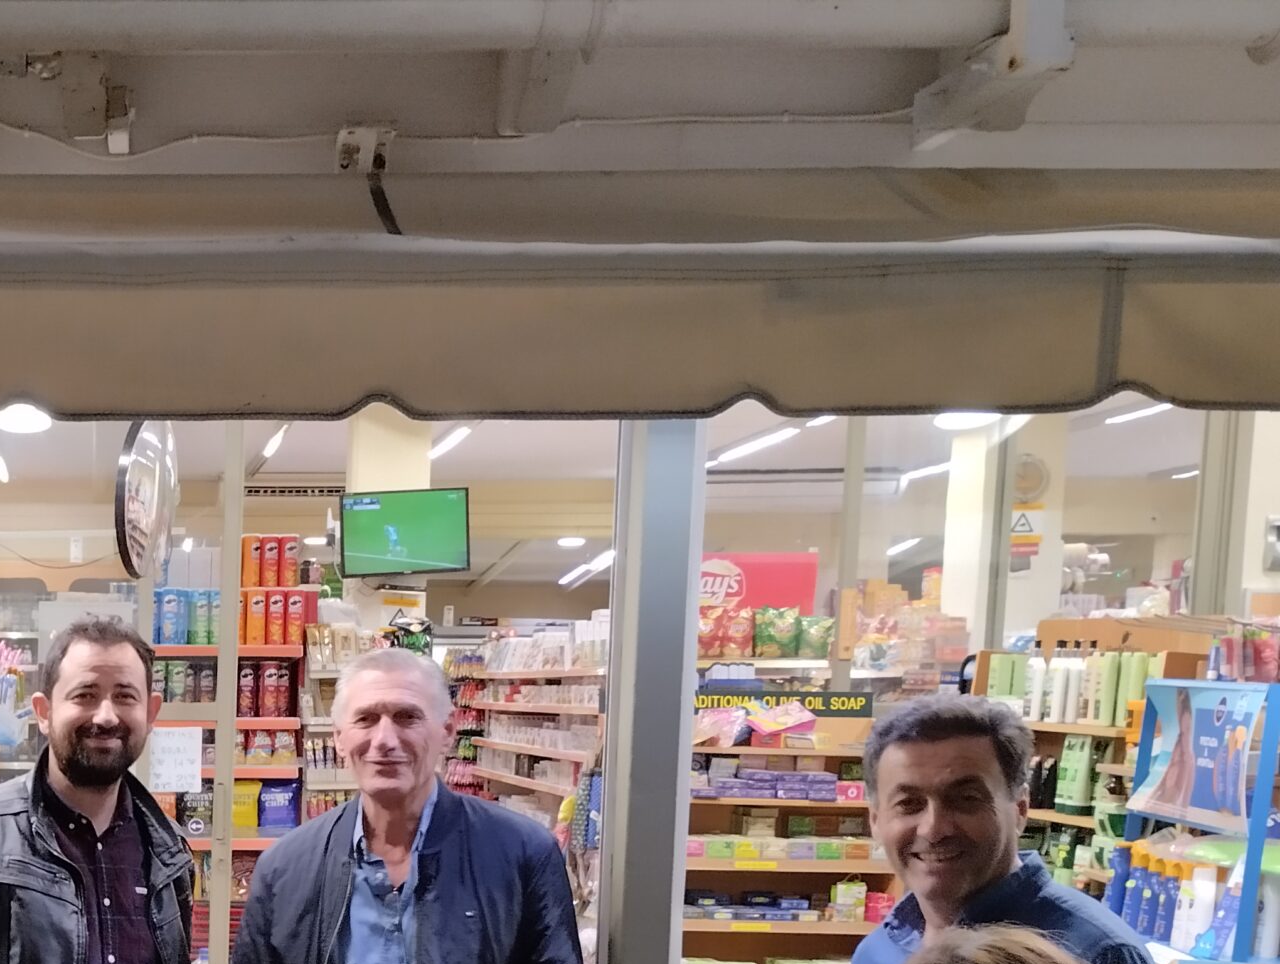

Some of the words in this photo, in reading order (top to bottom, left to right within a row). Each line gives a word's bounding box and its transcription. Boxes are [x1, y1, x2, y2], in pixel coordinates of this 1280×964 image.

[699, 574, 741, 605] ay's
[694, 696, 757, 709] ADITIONA
[805, 697, 826, 710] OIL
[830, 697, 866, 710] SOAP
